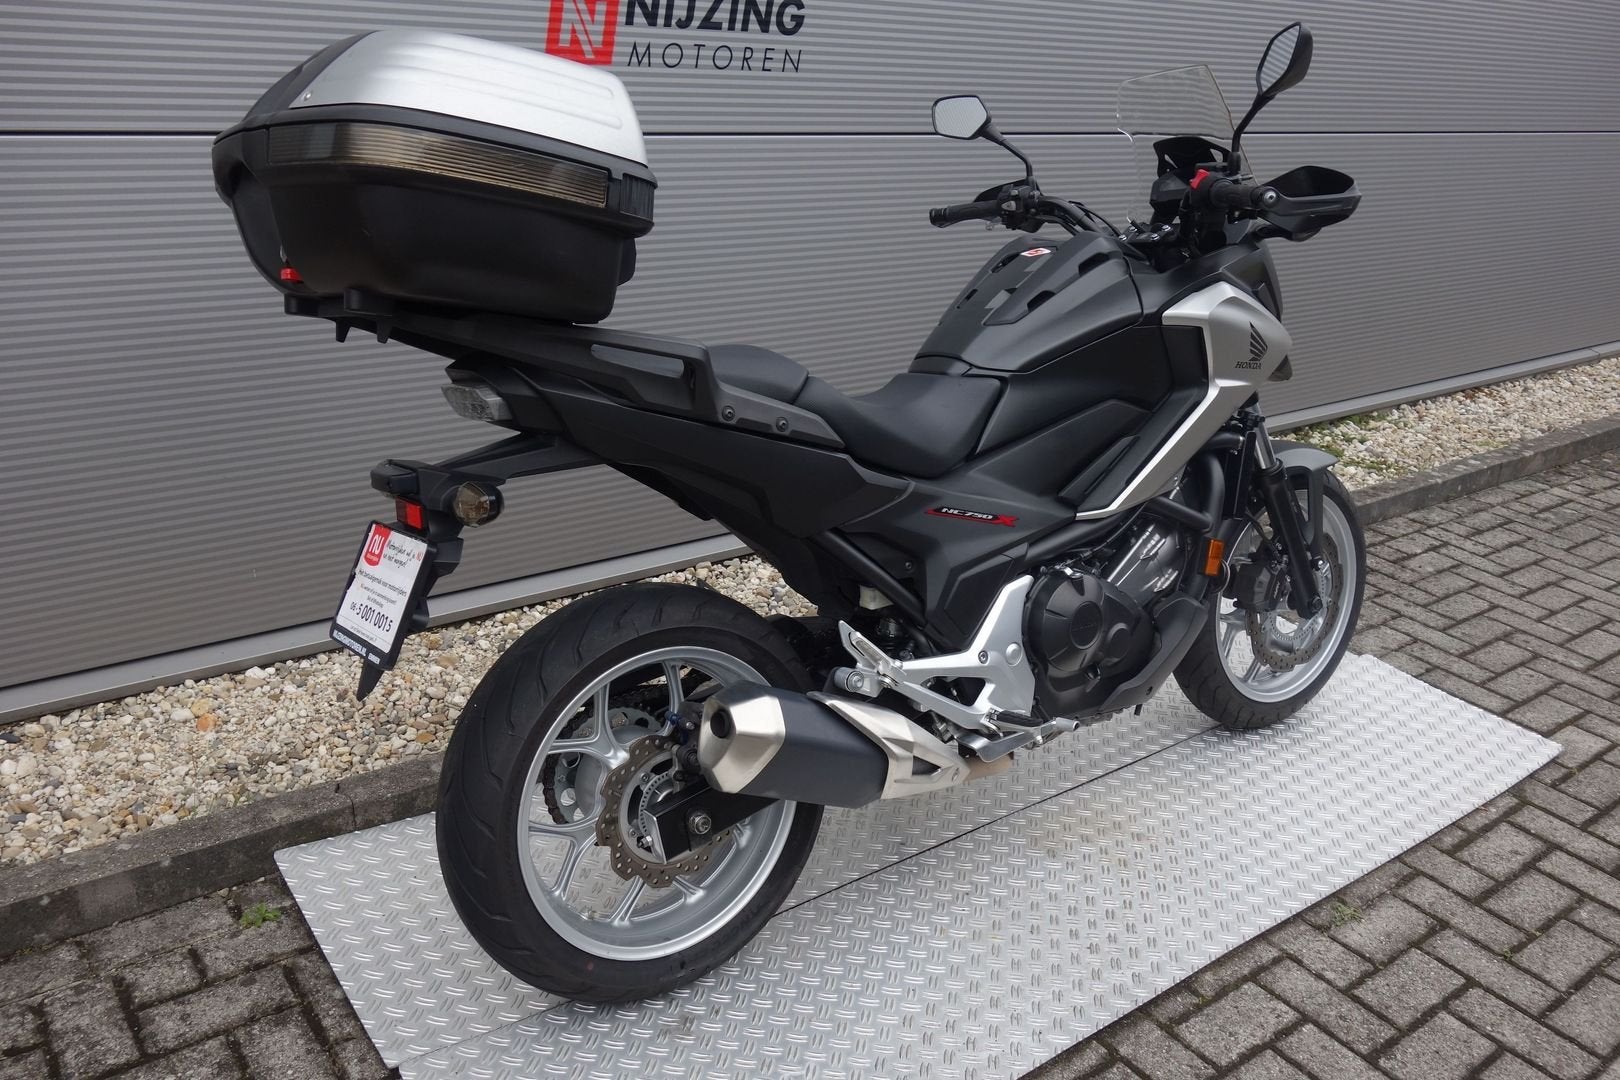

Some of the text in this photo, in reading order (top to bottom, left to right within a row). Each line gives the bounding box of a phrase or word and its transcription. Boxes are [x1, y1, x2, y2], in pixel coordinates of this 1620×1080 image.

[625, 0, 806, 36] NIJZING
[627, 41, 803, 73] MOTOREN
[1233, 360, 1262, 370] HONDA
